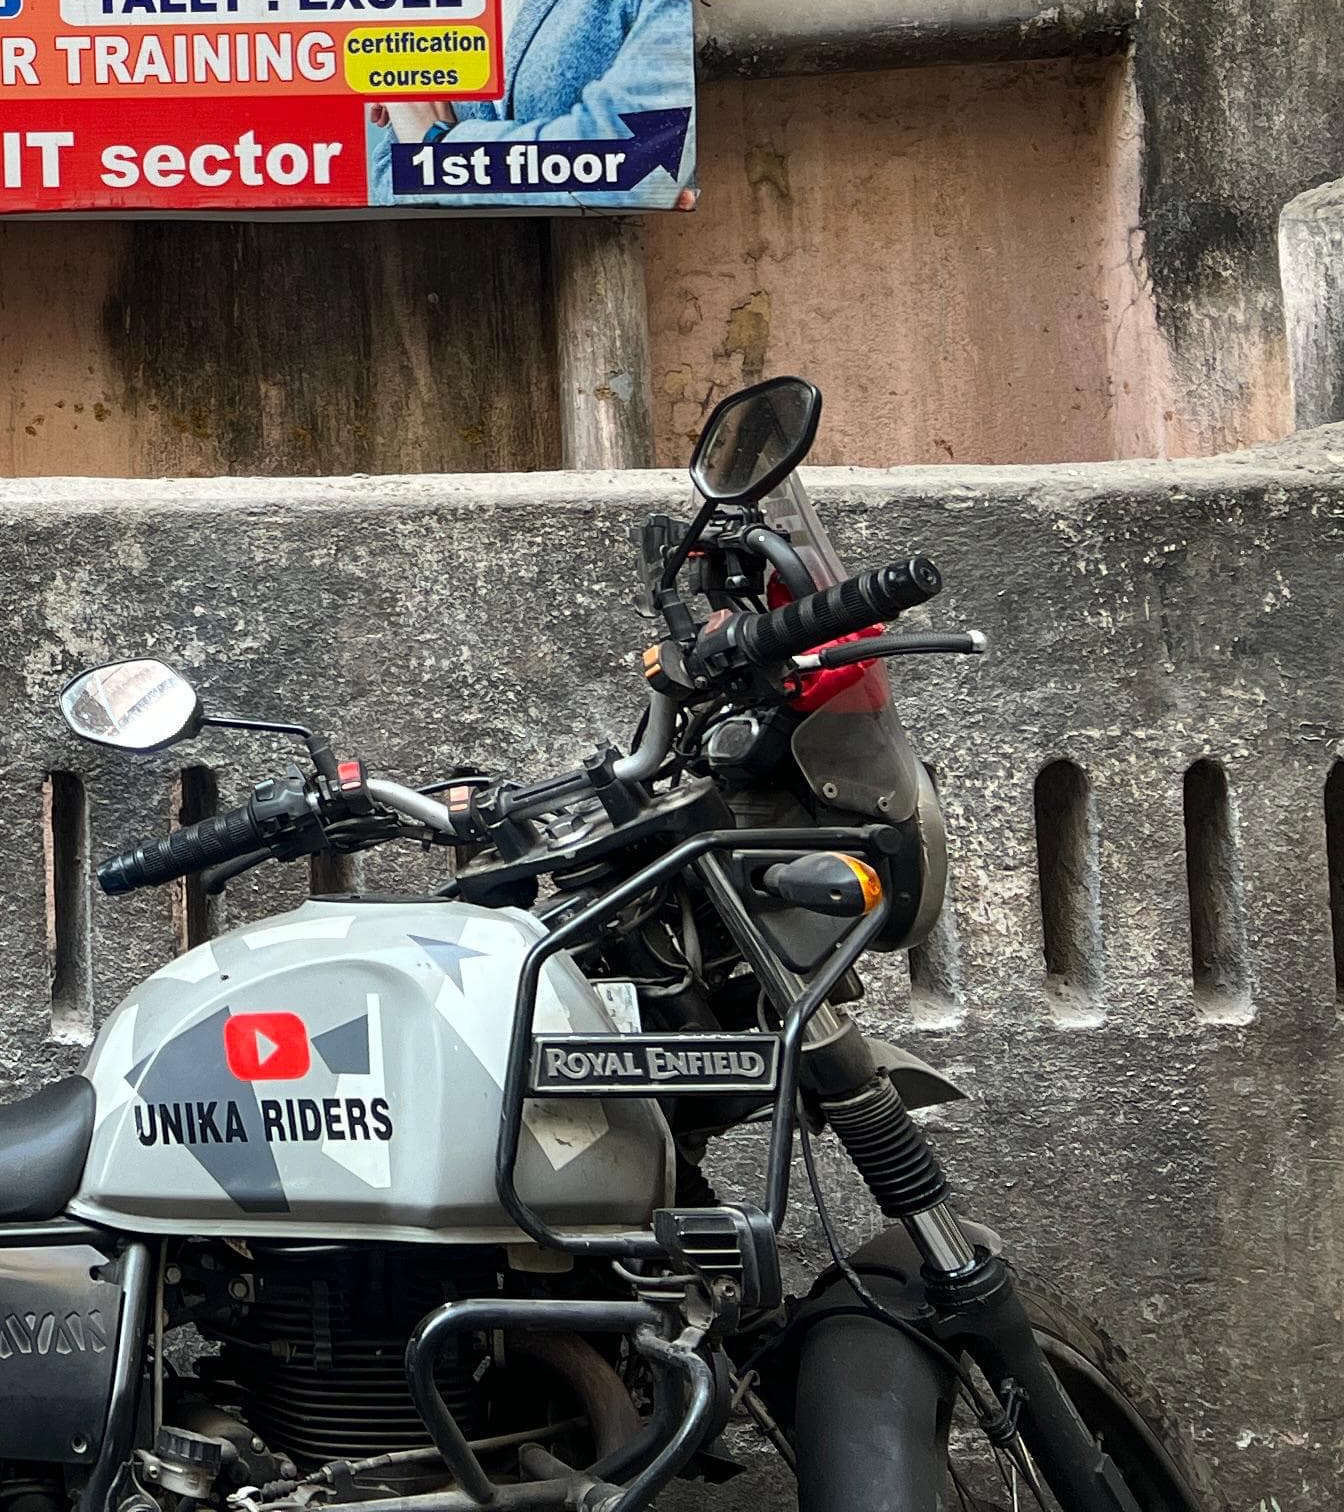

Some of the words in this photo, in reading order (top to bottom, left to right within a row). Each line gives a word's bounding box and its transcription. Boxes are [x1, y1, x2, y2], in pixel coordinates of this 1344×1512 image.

[57, 31, 337, 85] TRAINING
[346, 31, 486, 56] certification
[368, 66, 459, 86] courses
[3, 132, 76, 188] IT
[99, 137, 343, 188] sector
[411, 146, 491, 188] 1st
[505, 141, 625, 185] floor
[546, 1048, 642, 1079] ROYAL
[647, 1048, 766, 1080] ENFIELD
[134, 1100, 247, 1147] UNIKA
[262, 1097, 393, 1142] RIDERS
